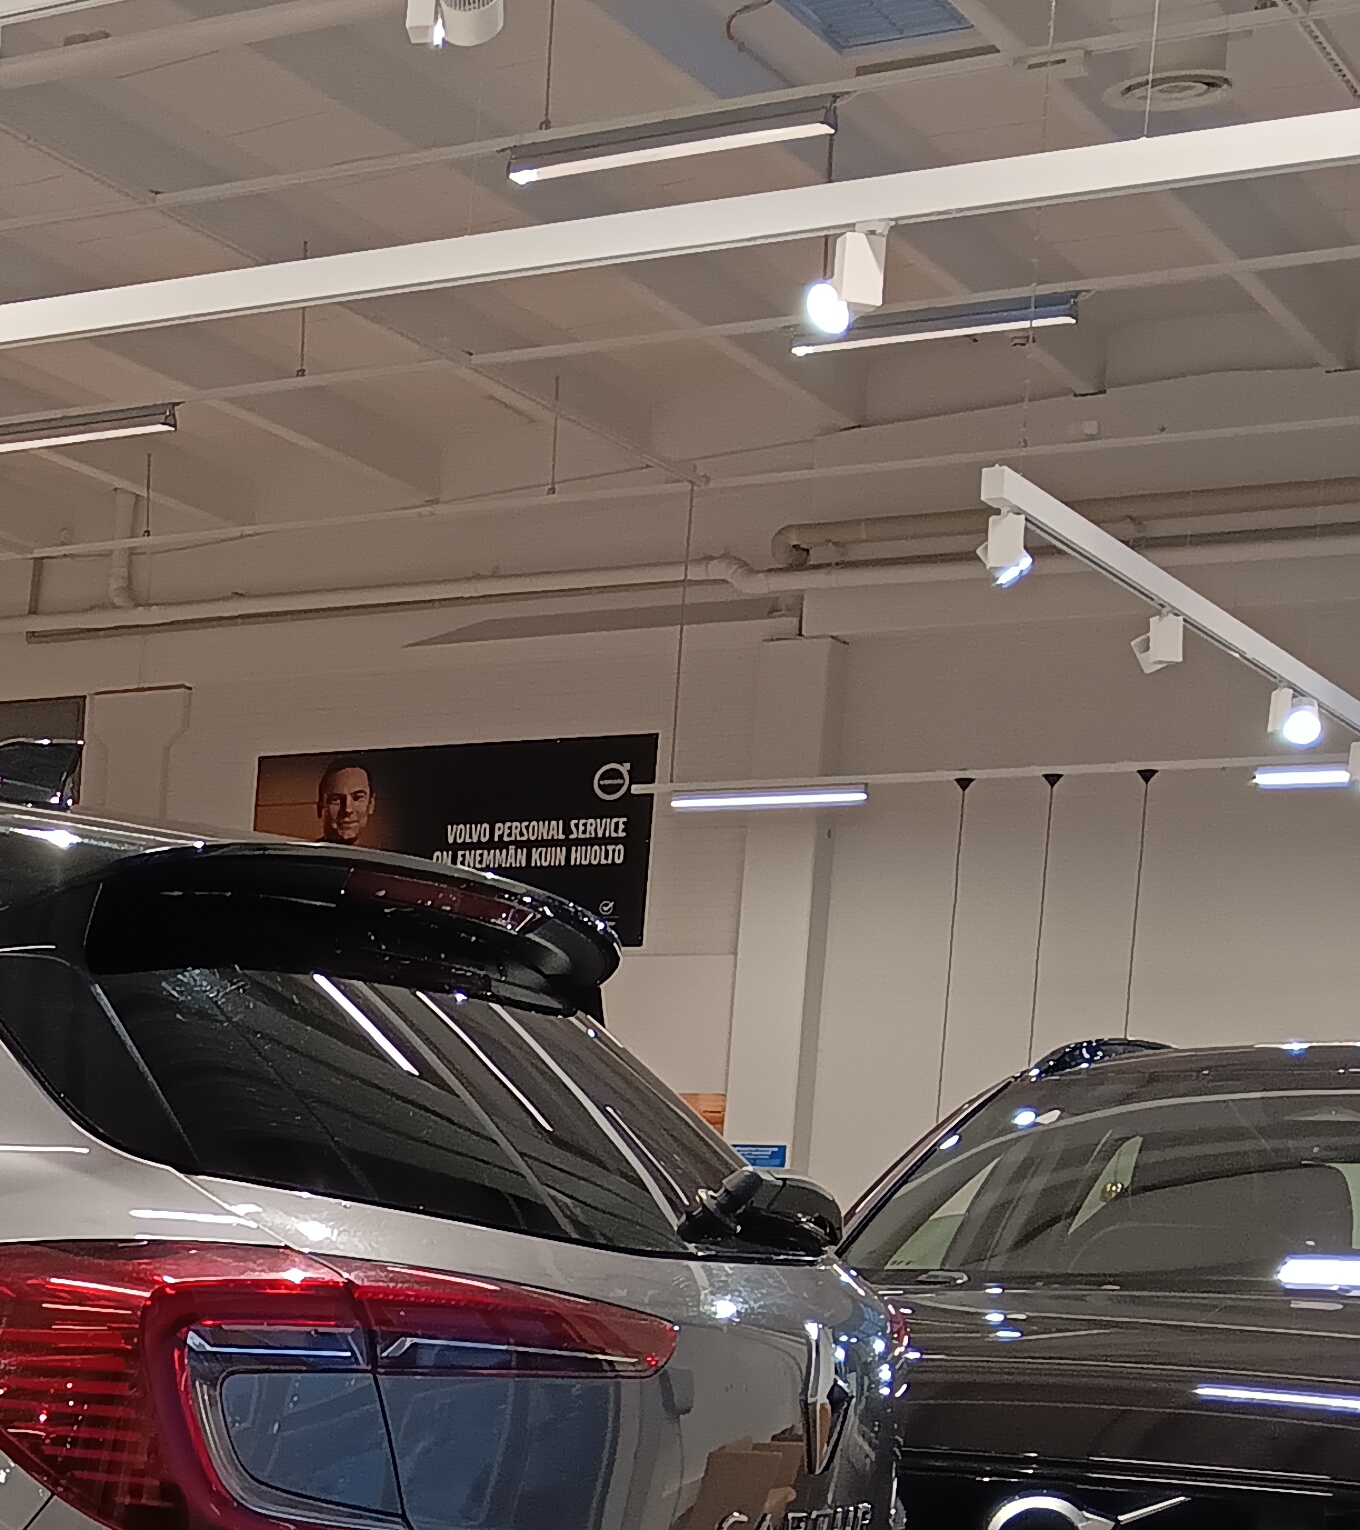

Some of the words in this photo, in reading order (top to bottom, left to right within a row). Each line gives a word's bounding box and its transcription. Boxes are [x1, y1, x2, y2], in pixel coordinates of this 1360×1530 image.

[447, 823, 490, 844] VOLVO
[494, 820, 566, 842] PERSONAL
[568, 817, 628, 840] SERVICE
[433, 850, 453, 867] ON
[456, 845, 527, 869] ENEMMÄN
[531, 846, 567, 868] KUIN
[570, 844, 626, 867] HUOLTO
